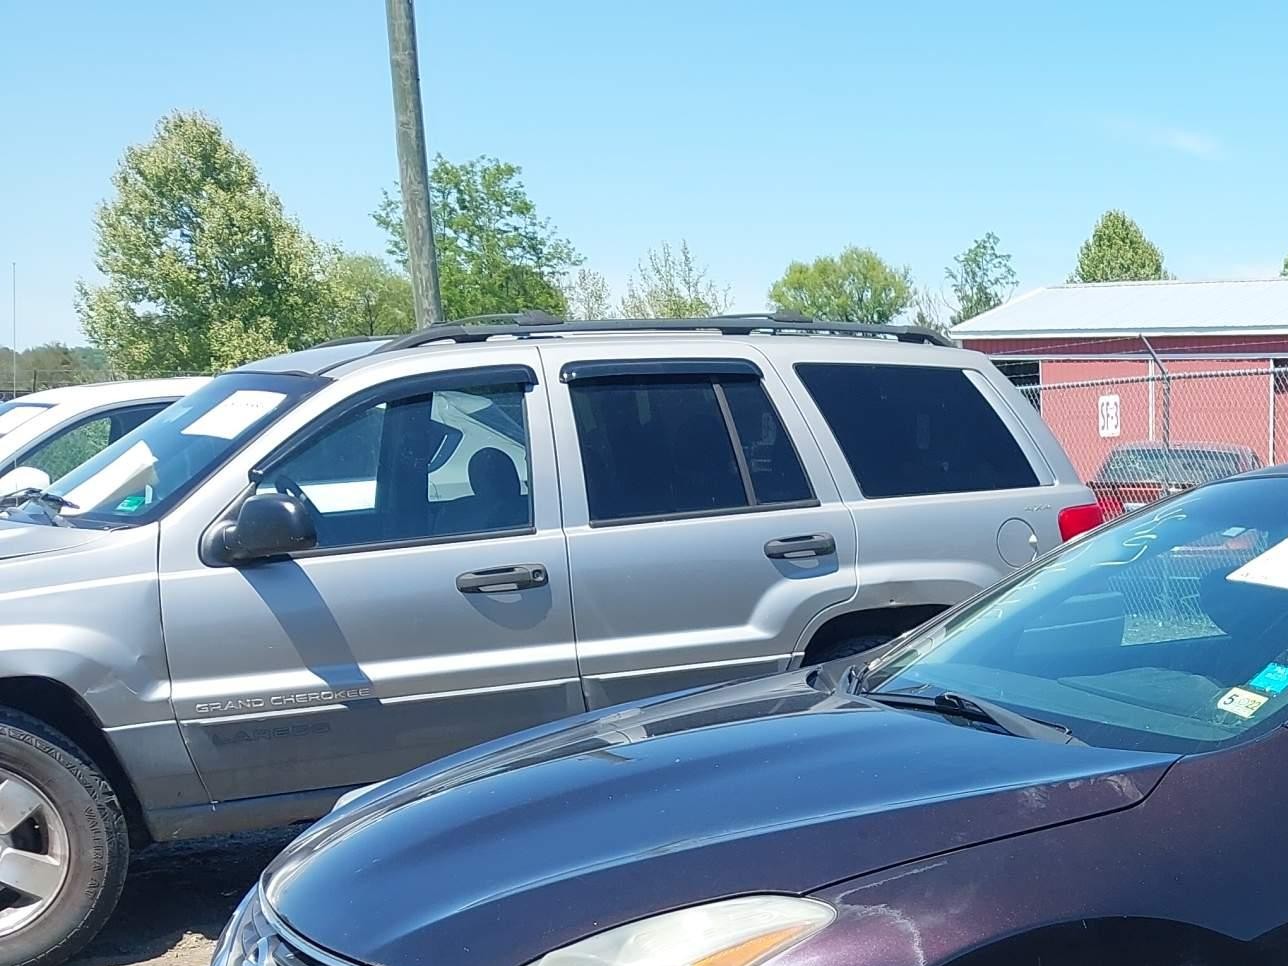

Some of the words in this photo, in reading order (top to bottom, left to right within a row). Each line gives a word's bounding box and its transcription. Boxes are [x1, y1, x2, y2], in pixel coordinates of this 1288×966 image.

[1101, 401, 1119, 431] SF-3
[195, 699, 265, 713] GRAND
[270, 687, 370, 706] CHEROKEE
[1224, 693, 1239, 705] 5
